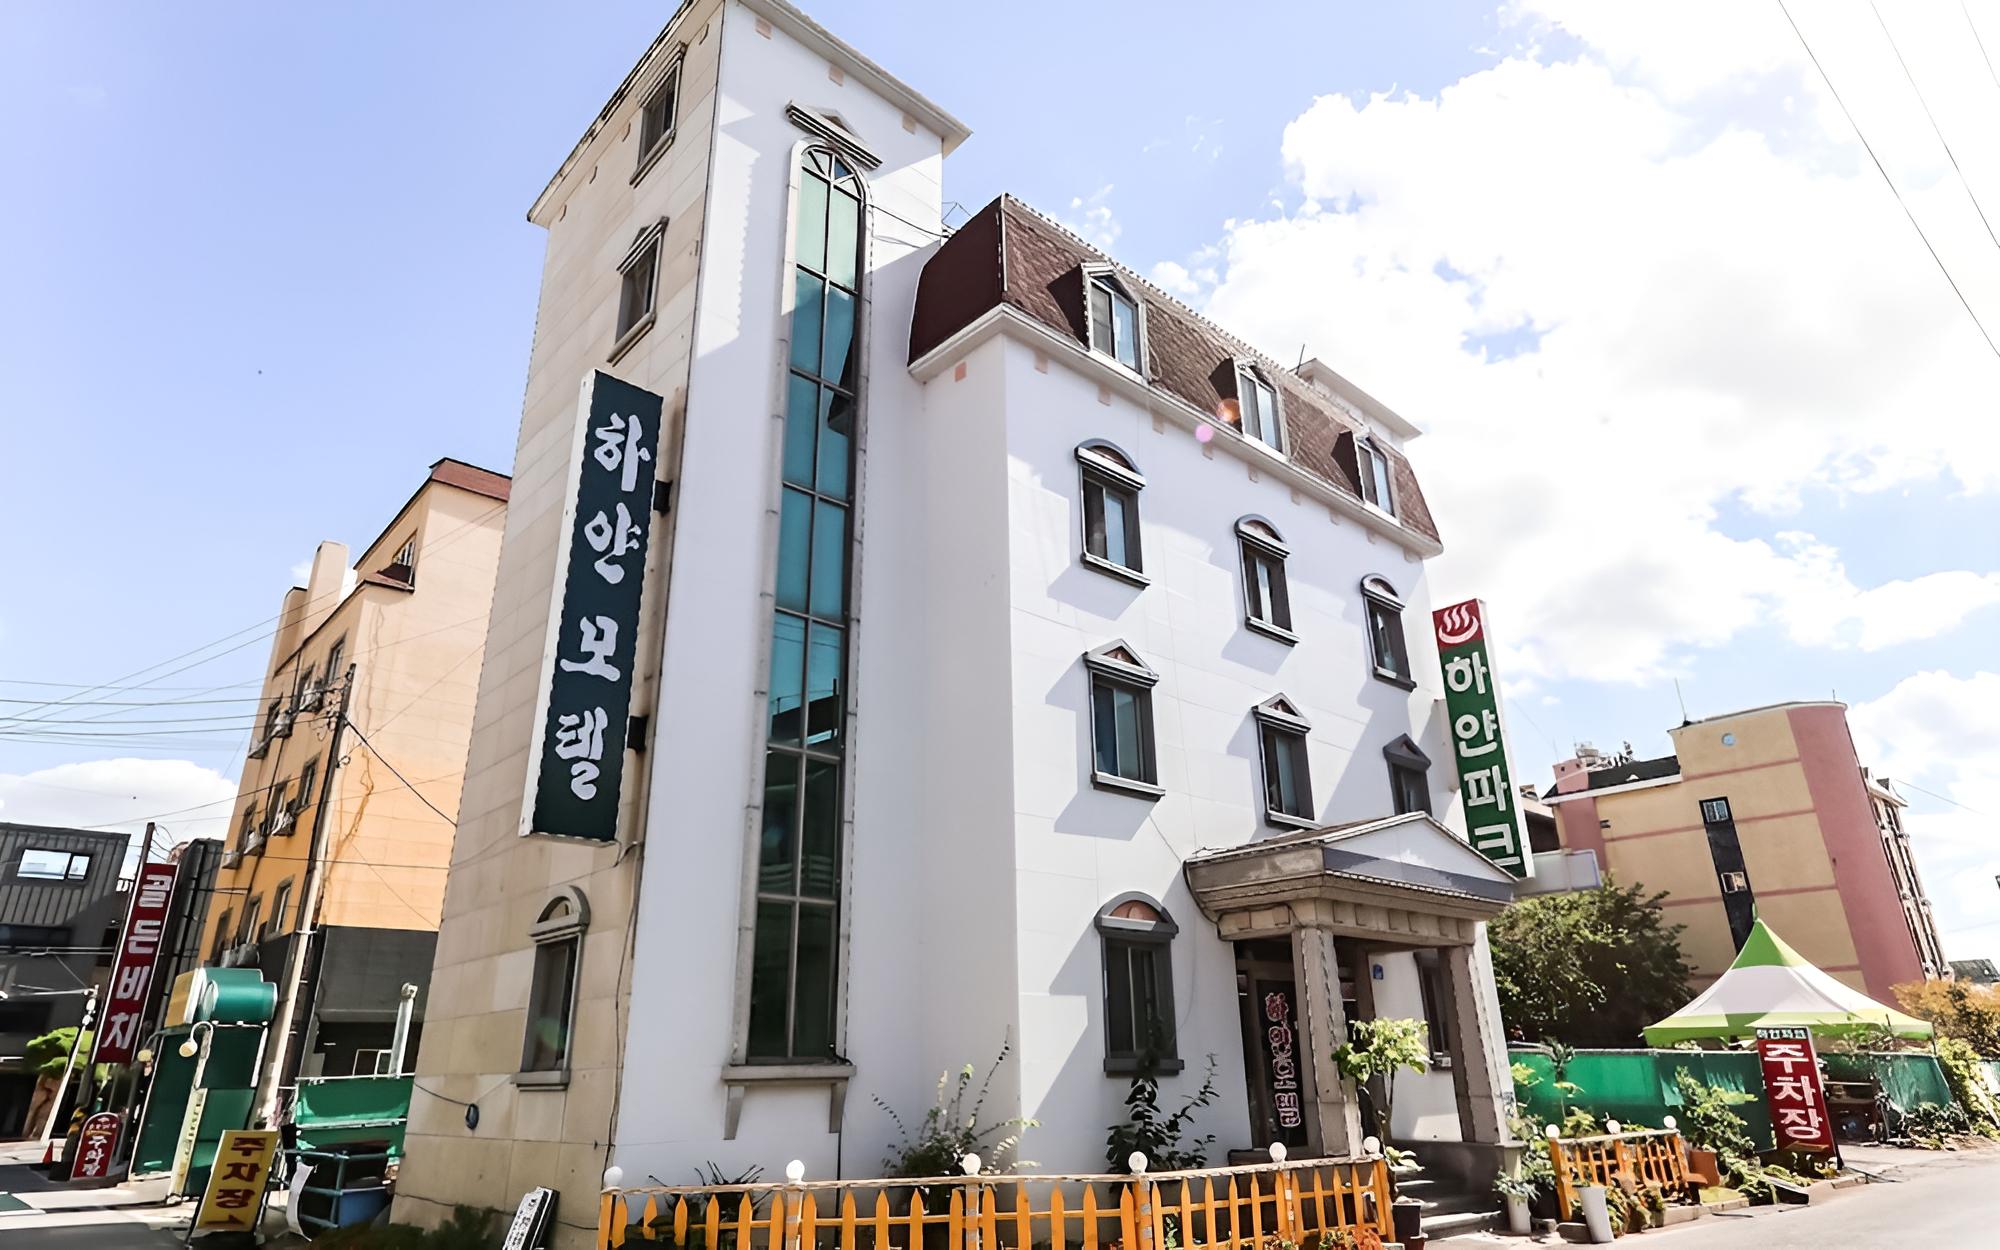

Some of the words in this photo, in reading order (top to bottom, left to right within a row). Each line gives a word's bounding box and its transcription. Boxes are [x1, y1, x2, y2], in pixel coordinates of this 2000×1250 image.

[555, 413, 651, 801] 하얀모텔
[1445, 651, 1520, 866] 하얀파크
[101, 874, 172, 1050] 골든비치
[1764, 1043, 1823, 1139] 주차장
